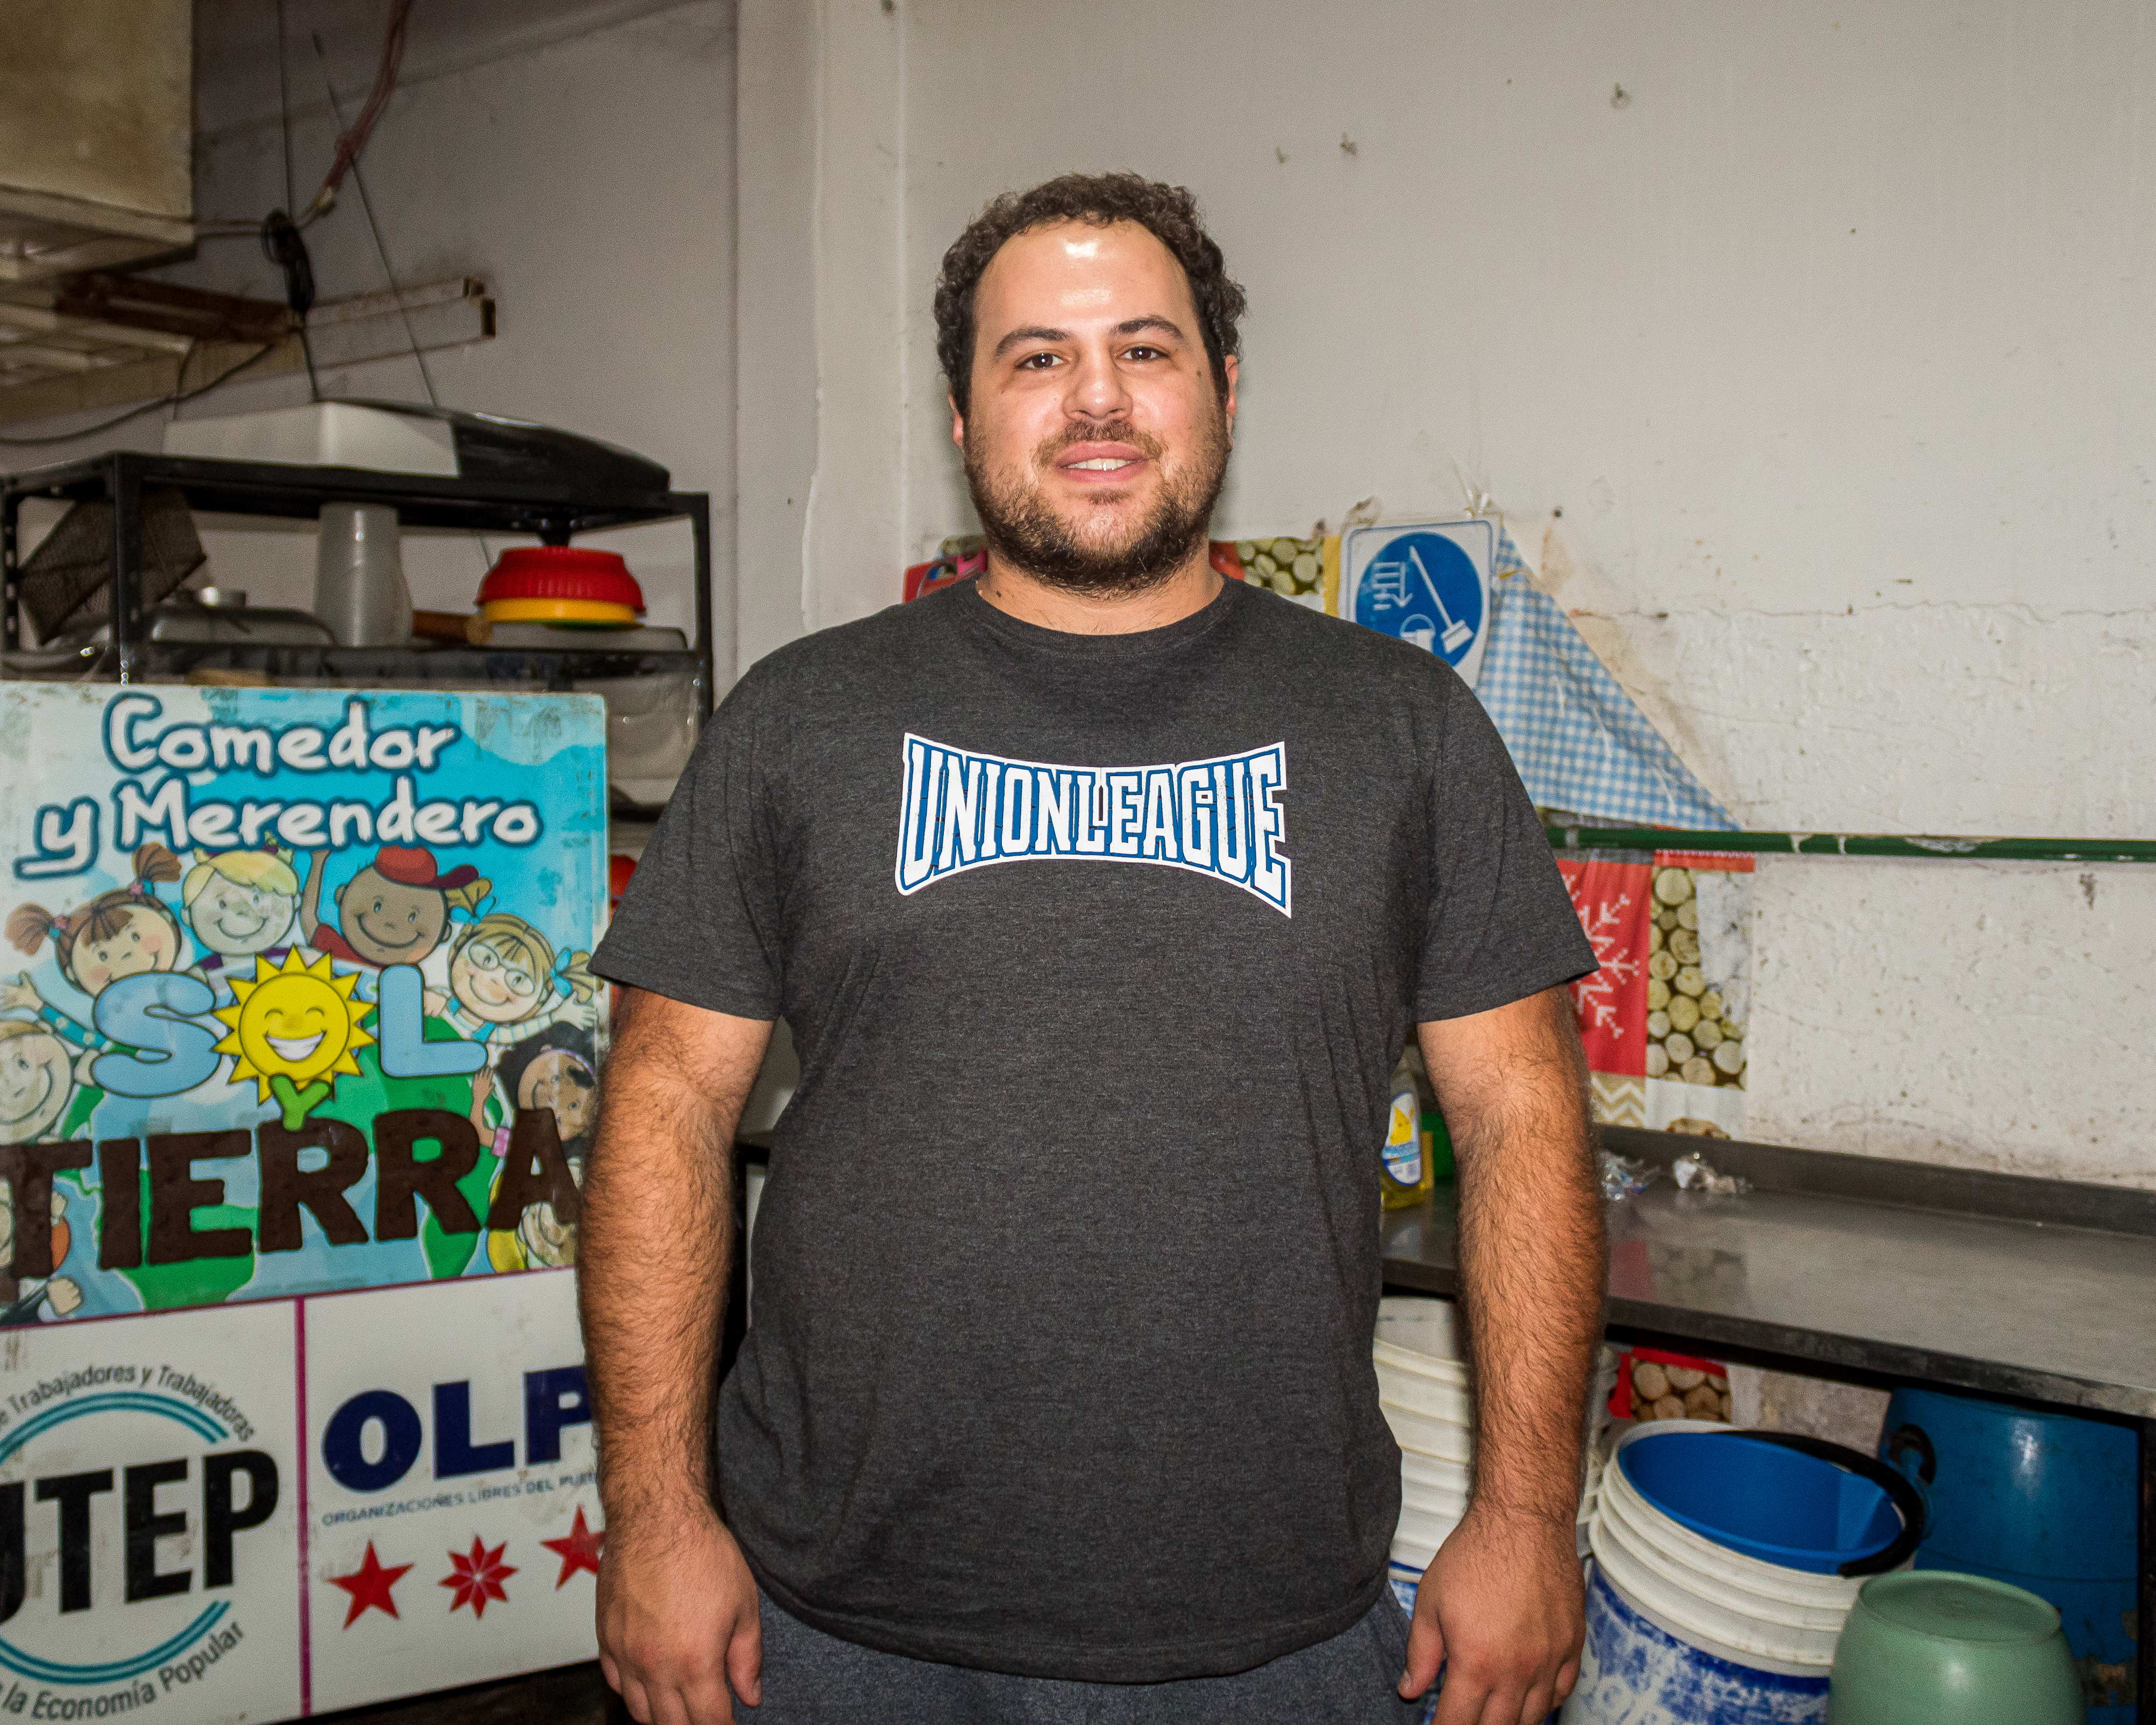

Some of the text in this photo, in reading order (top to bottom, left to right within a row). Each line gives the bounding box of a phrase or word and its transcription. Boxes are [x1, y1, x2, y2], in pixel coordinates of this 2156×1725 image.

[103, 692, 460, 777] Comedor
[15, 770, 543, 879] y Merendero
[0, 1108, 581, 1279] TIERRA
[8, 1364, 136, 1414] Trabajadores
[141, 1367, 153, 1387] y
[158, 1365, 255, 1442] Trabajadoras
[322, 1365, 595, 1494] OLP
[323, 1492, 465, 1527] ORGANIZACIONES
[467, 1483, 522, 1504] LIBRES
[526, 1478, 554, 1495] DEL
[3, 1621, 244, 1721] la Economía Popular
